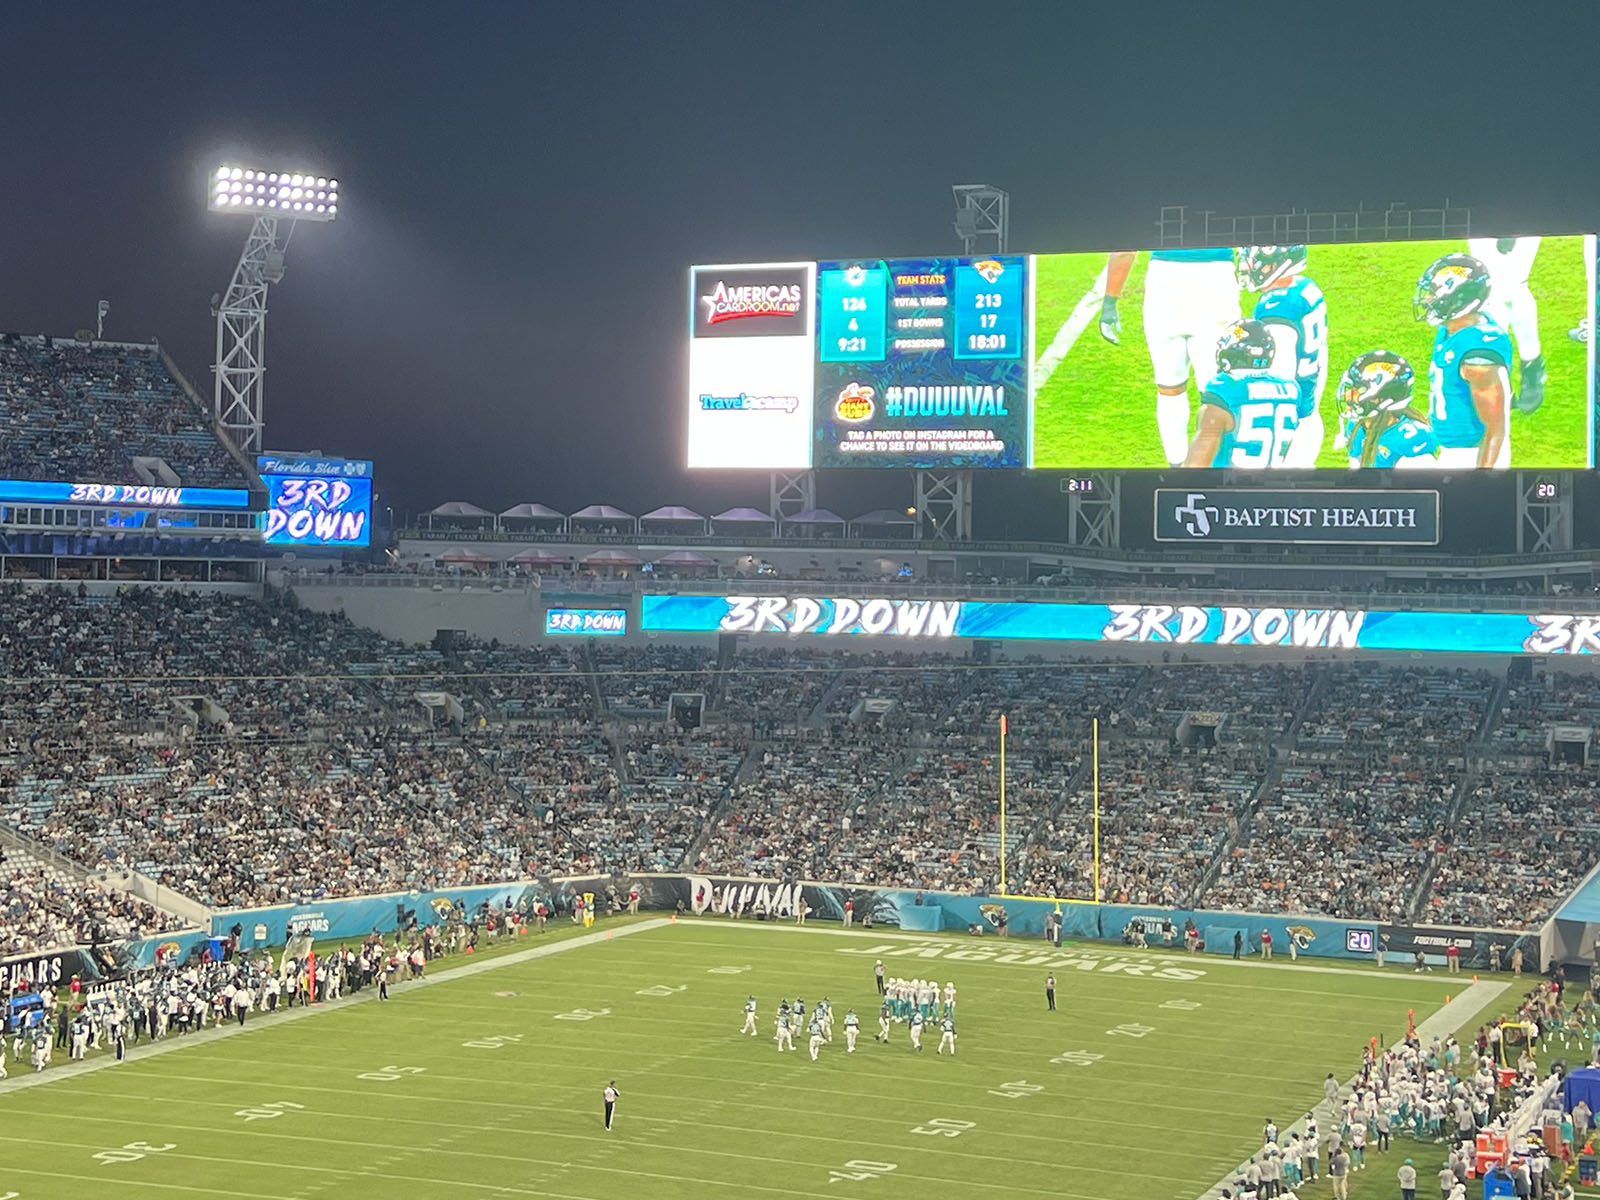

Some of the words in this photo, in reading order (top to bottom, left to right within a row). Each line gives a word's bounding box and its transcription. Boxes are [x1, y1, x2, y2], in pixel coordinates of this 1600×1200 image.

[897, 275, 919, 285] TEAM
[920, 275, 946, 285] STATS
[703, 281, 800, 302] AMERICAS
[717, 302, 800, 312] CARDROOM.net
[894, 297, 919, 307] TOTAL
[975, 294, 1002, 309] 213
[980, 314, 997, 328] 17
[838, 337, 866, 352] 9:21
[969, 334, 1006, 350] 18:01
[885, 385, 1008, 417] #DUUUVAL
[847, 430, 865, 440] TAG
[865, 430, 873, 440] A
[873, 430, 902, 440] PHOTO
[903, 430, 916, 440] ON
[917, 430, 967, 440] INSTAGRAM
[967, 430, 986, 440] FOR
[986, 430, 994, 440] A
[840, 441, 875, 451] CHANCE
[876, 441, 888, 451] TO
[888, 441, 905, 451] SEE
[906, 441, 915, 451] IT
[915, 441, 929, 451] ON
[930, 441, 947, 451] THE
[948, 441, 1004, 451] VIDEOBOARD
[264, 460, 313, 473] Florida
[313, 462, 341, 474] Blue
[70, 483, 117, 501] 3RD
[120, 485, 182, 504] DOWN
[277, 480, 352, 510] 3RD
[1539, 484, 1555, 496] 20
[263, 509, 365, 541] DOWN
[1224, 507, 1317, 527] BAPTIST
[1322, 508, 1416, 528] HEALTH
[549, 614, 581, 629] 3RD
[583, 614, 624, 630] DOWN
[720, 596, 821, 632] 3RD
[827, 598, 961, 636] DOWN
[1101, 604, 1209, 644] 3RD
[1216, 607, 1365, 648] DOWN
[1350, 933, 1371, 949] 20
[834, 945, 1208, 980] JAGUARS
[909, 1118, 977, 1137] 50
[829, 1159, 898, 1181] 40
